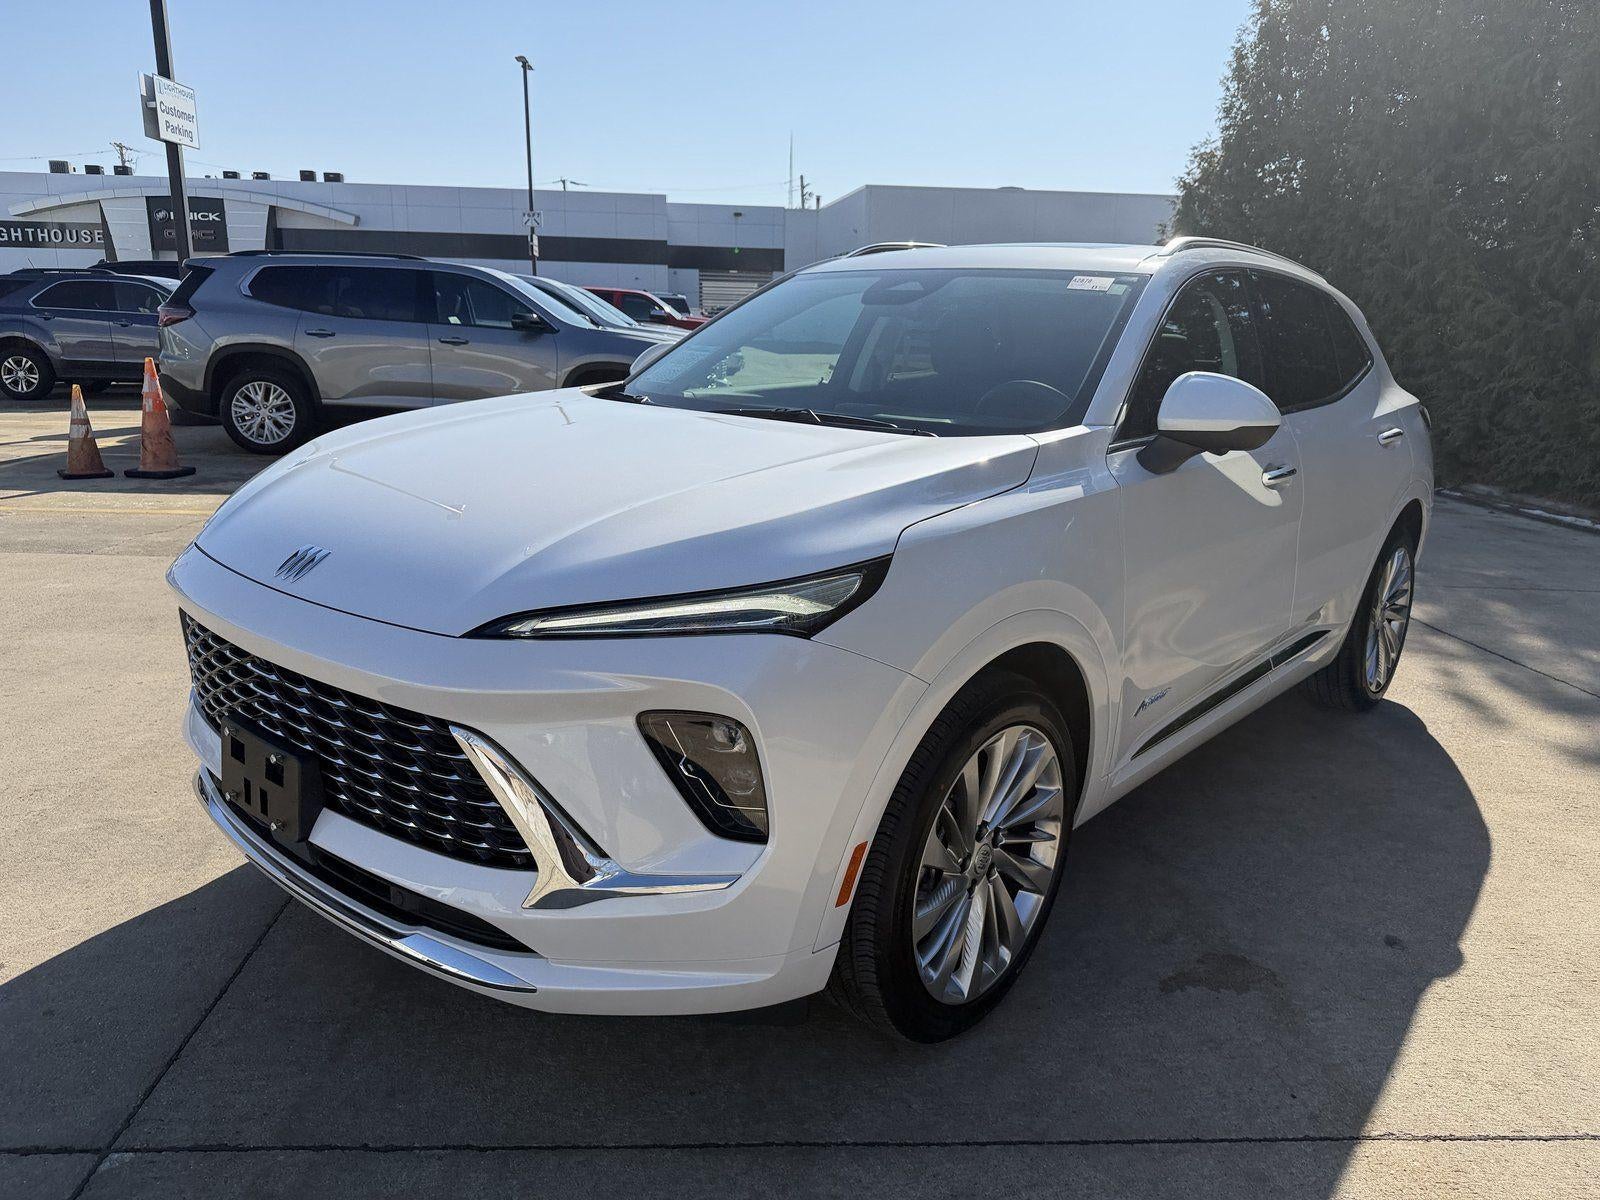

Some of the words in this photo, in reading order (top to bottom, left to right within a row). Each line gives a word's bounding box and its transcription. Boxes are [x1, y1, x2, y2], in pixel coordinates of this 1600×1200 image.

[160, 101, 194, 123] Customer
[165, 120, 193, 142] Parking
[0, 227, 104, 243] GHTHOUSE
